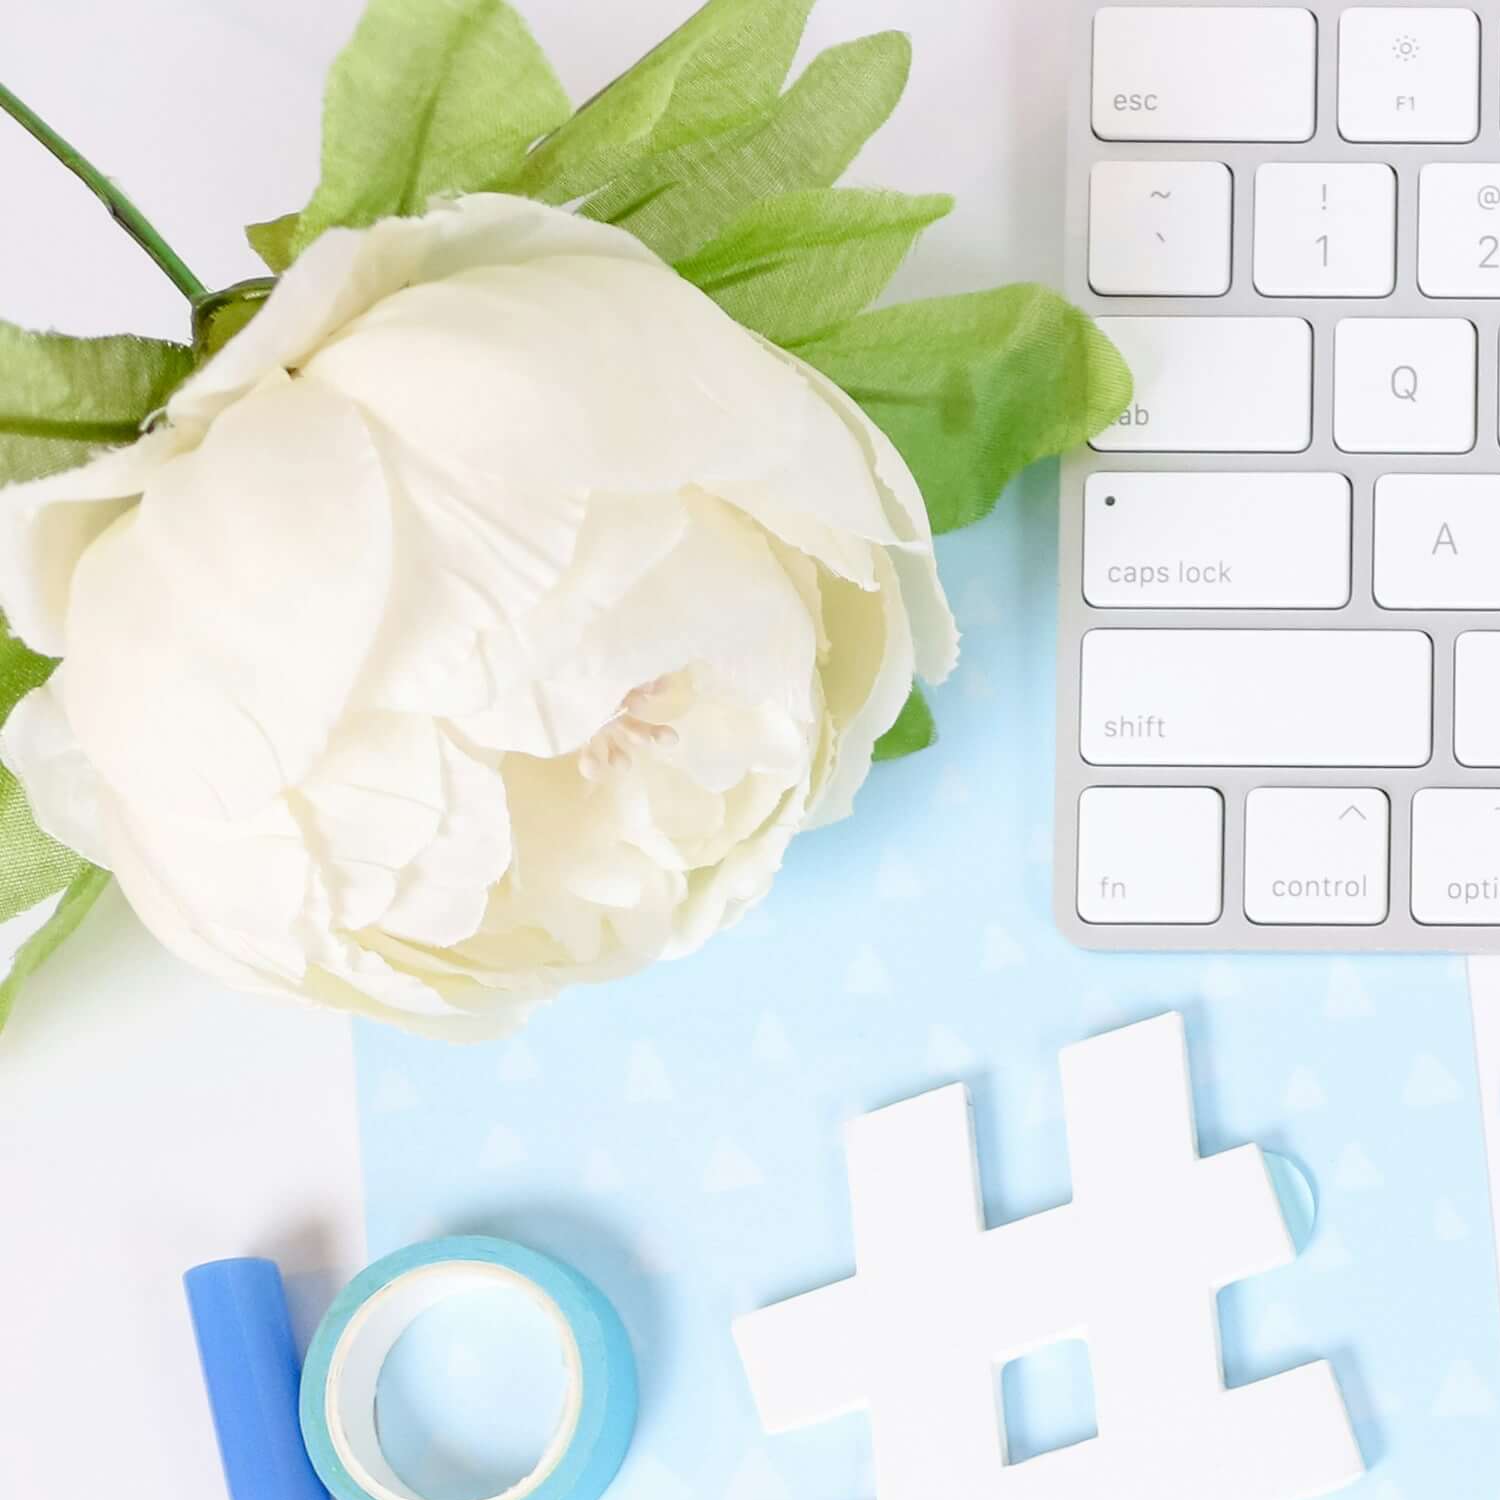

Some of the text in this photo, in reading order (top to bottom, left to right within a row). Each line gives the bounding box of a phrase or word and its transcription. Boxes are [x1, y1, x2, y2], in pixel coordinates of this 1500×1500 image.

[1113, 93, 1158, 112] esc
[1395, 95, 1416, 111] F1
[1315, 234, 1328, 267] 1
[1478, 234, 1500, 269] 2
[1390, 365, 1418, 403] Q
[1111, 403, 1149, 426] ab
[1431, 521, 1459, 556] A
[1107, 560, 1232, 588] caps lock
[1103, 715, 1166, 739] shift
[1100, 876, 1126, 899] fn
[1271, 874, 1367, 897] control
